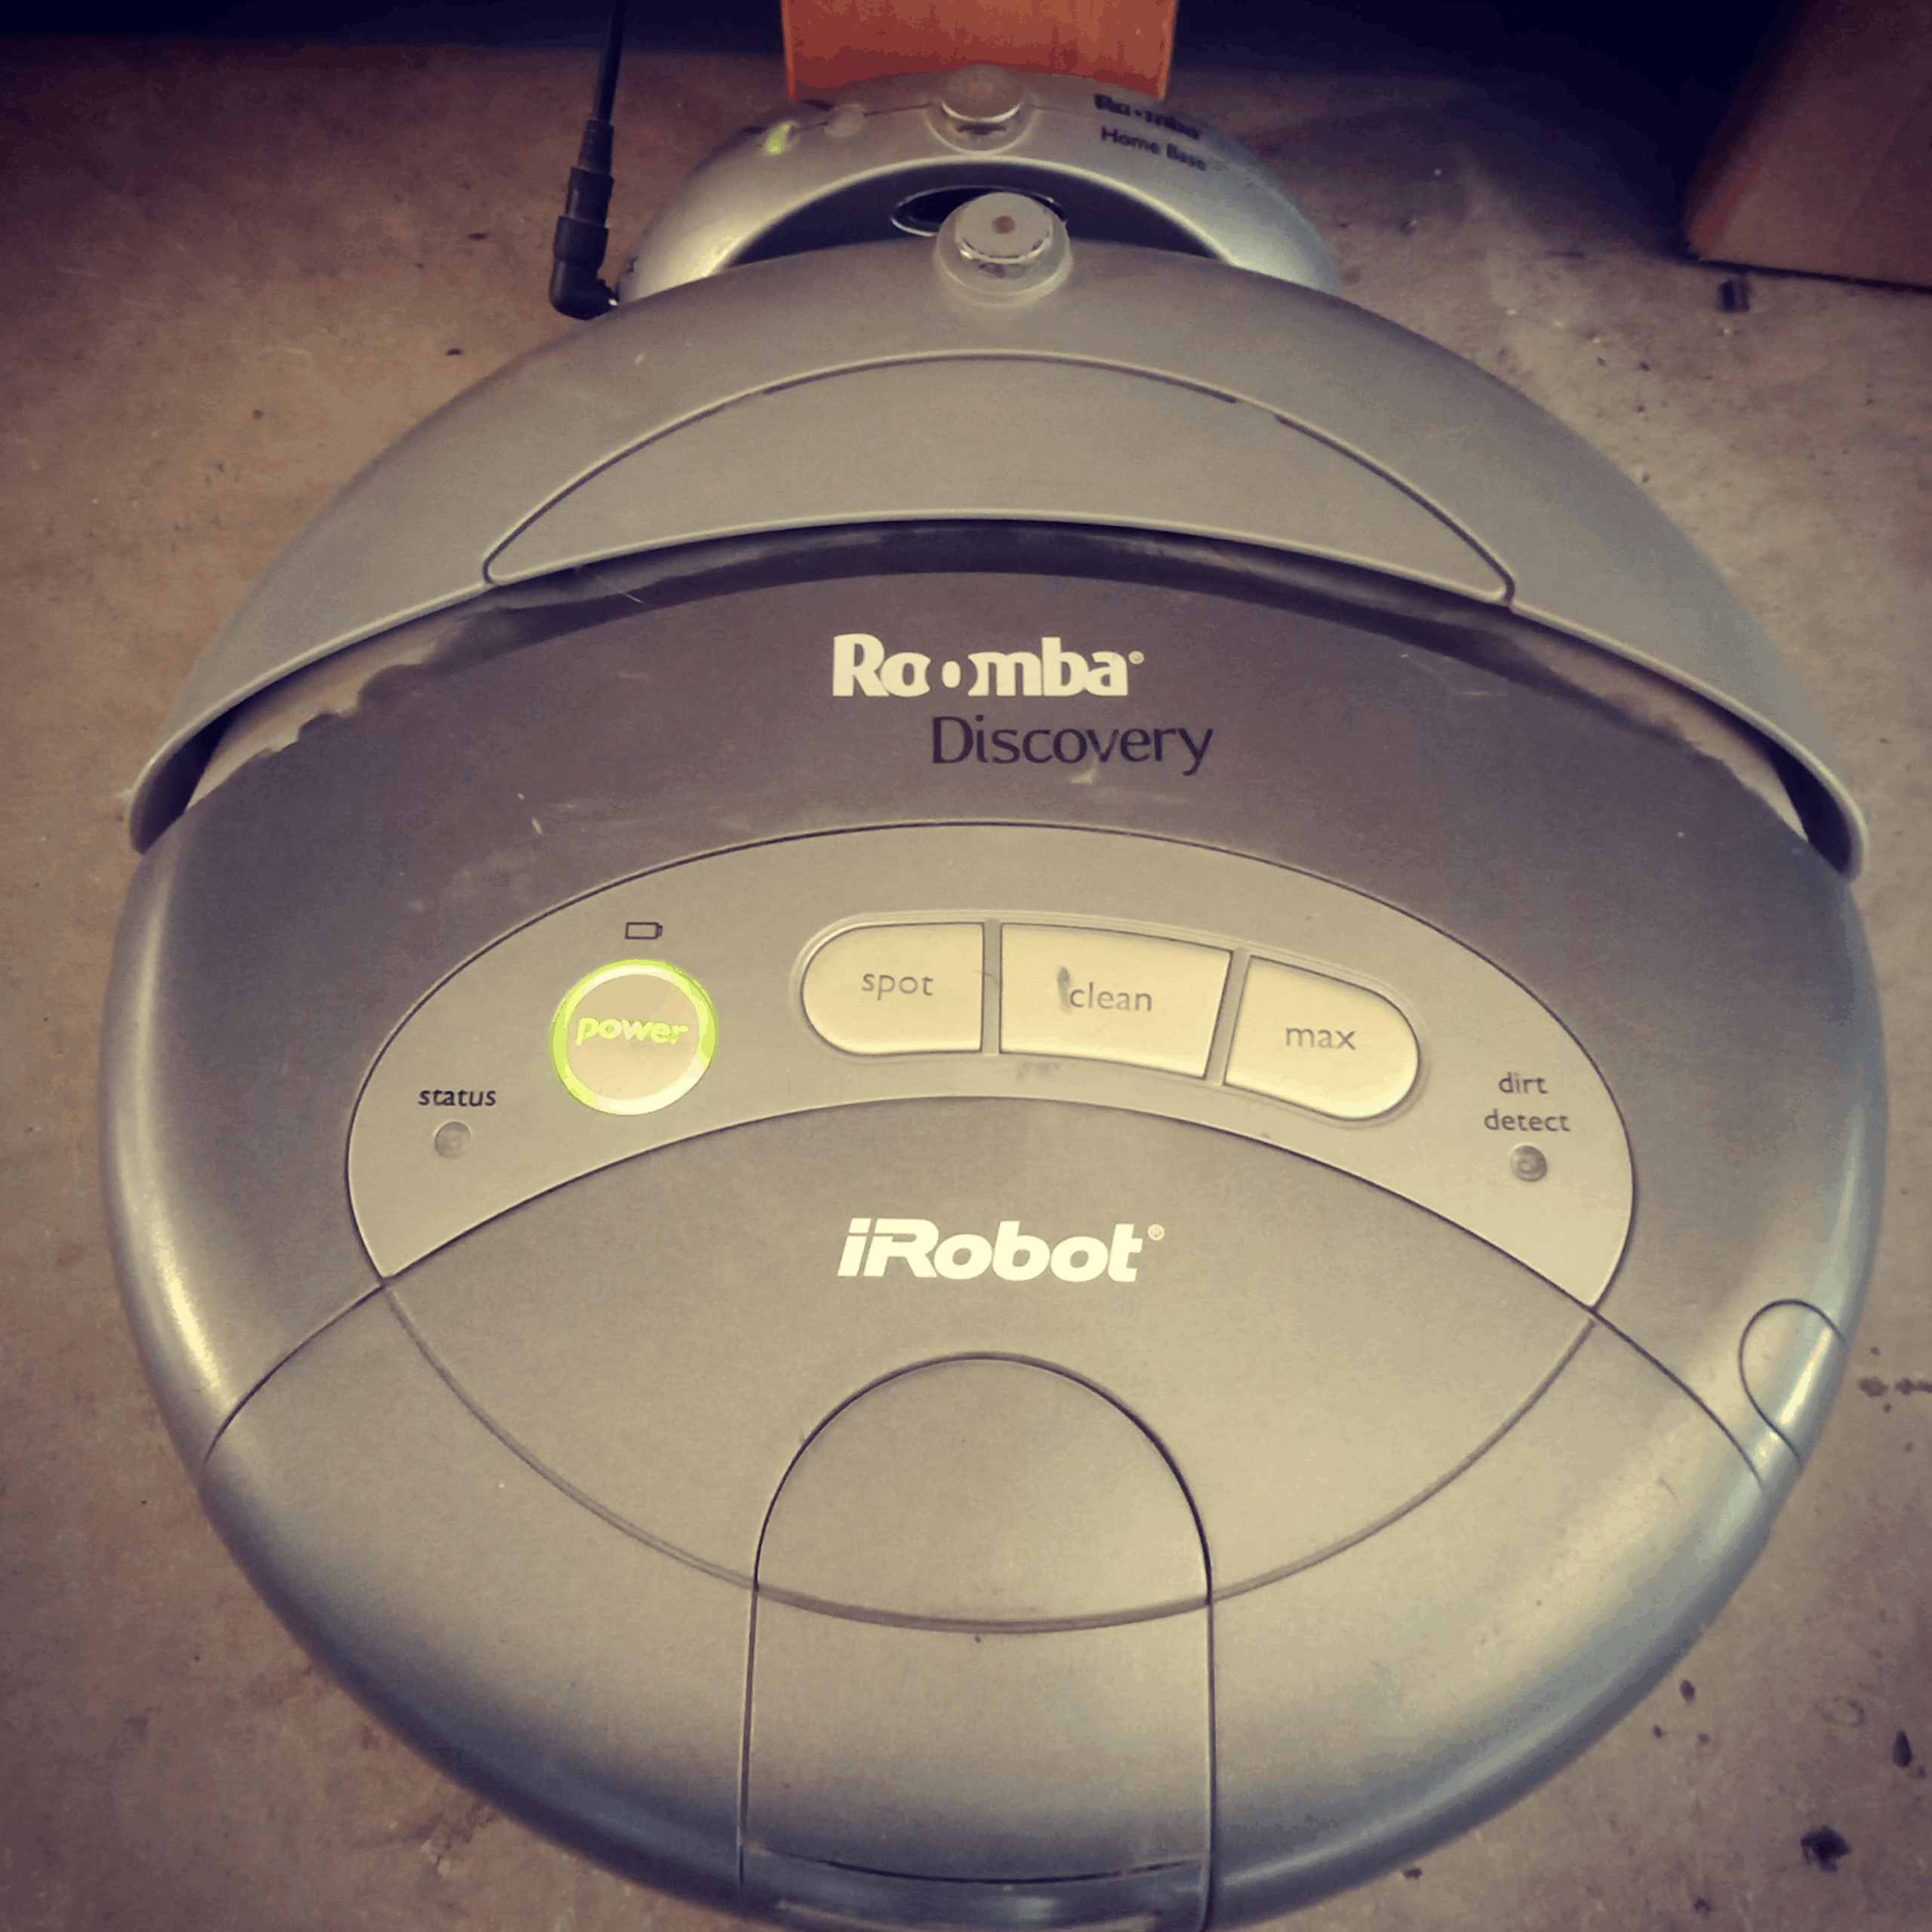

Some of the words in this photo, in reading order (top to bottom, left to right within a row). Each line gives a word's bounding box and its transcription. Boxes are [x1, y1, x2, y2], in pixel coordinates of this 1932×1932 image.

[1101, 126, 1161, 155] Home
[931, 715, 1214, 776] Discovery
[861, 971, 934, 1000] spot
[1069, 982, 1153, 1013] clean
[577, 1017, 688, 1046] power
[1285, 1026, 1356, 1051] max
[418, 1088, 497, 1107] status
[1498, 1072, 1549, 1094] dirt
[1484, 1108, 1571, 1132] detect
[837, 1217, 1144, 1283] iRobot
